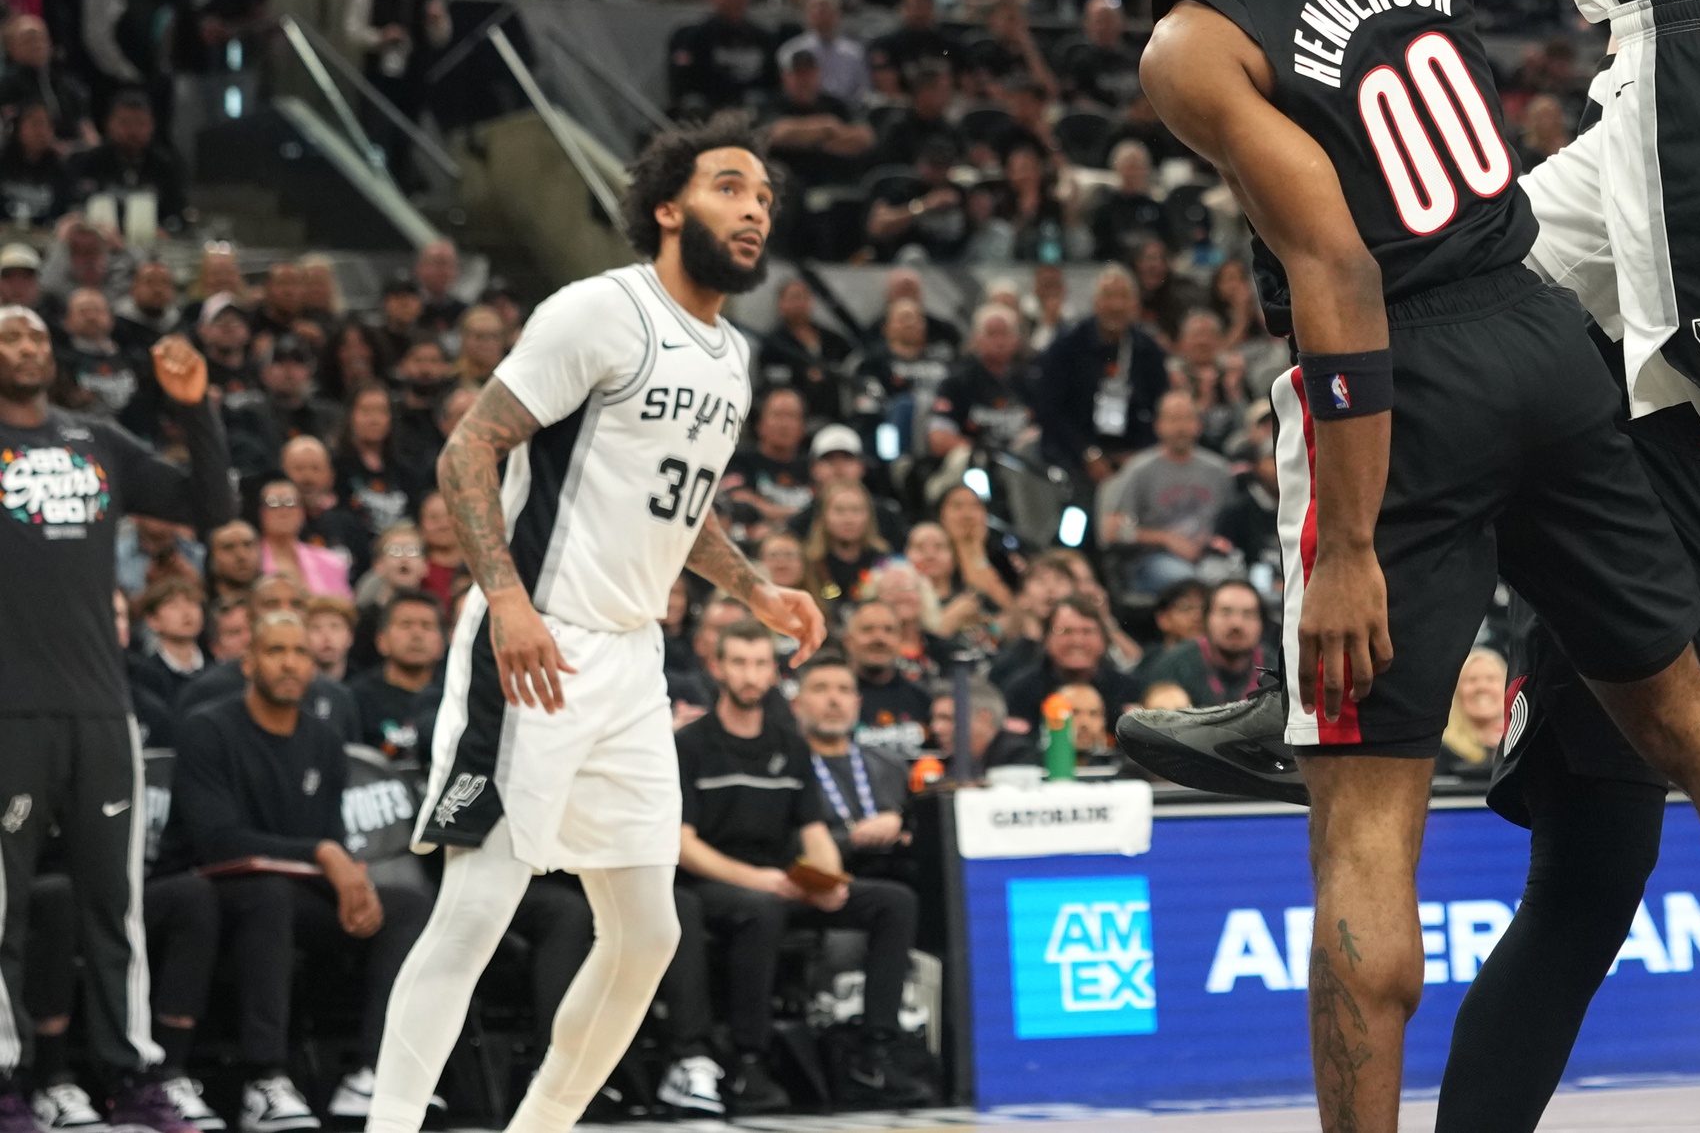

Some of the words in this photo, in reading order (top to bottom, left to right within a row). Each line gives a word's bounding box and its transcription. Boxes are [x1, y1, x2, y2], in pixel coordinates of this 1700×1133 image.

[1357, 30, 1512, 237] 00
[647, 454, 716, 529] 30
[1045, 901, 1151, 962] AM
